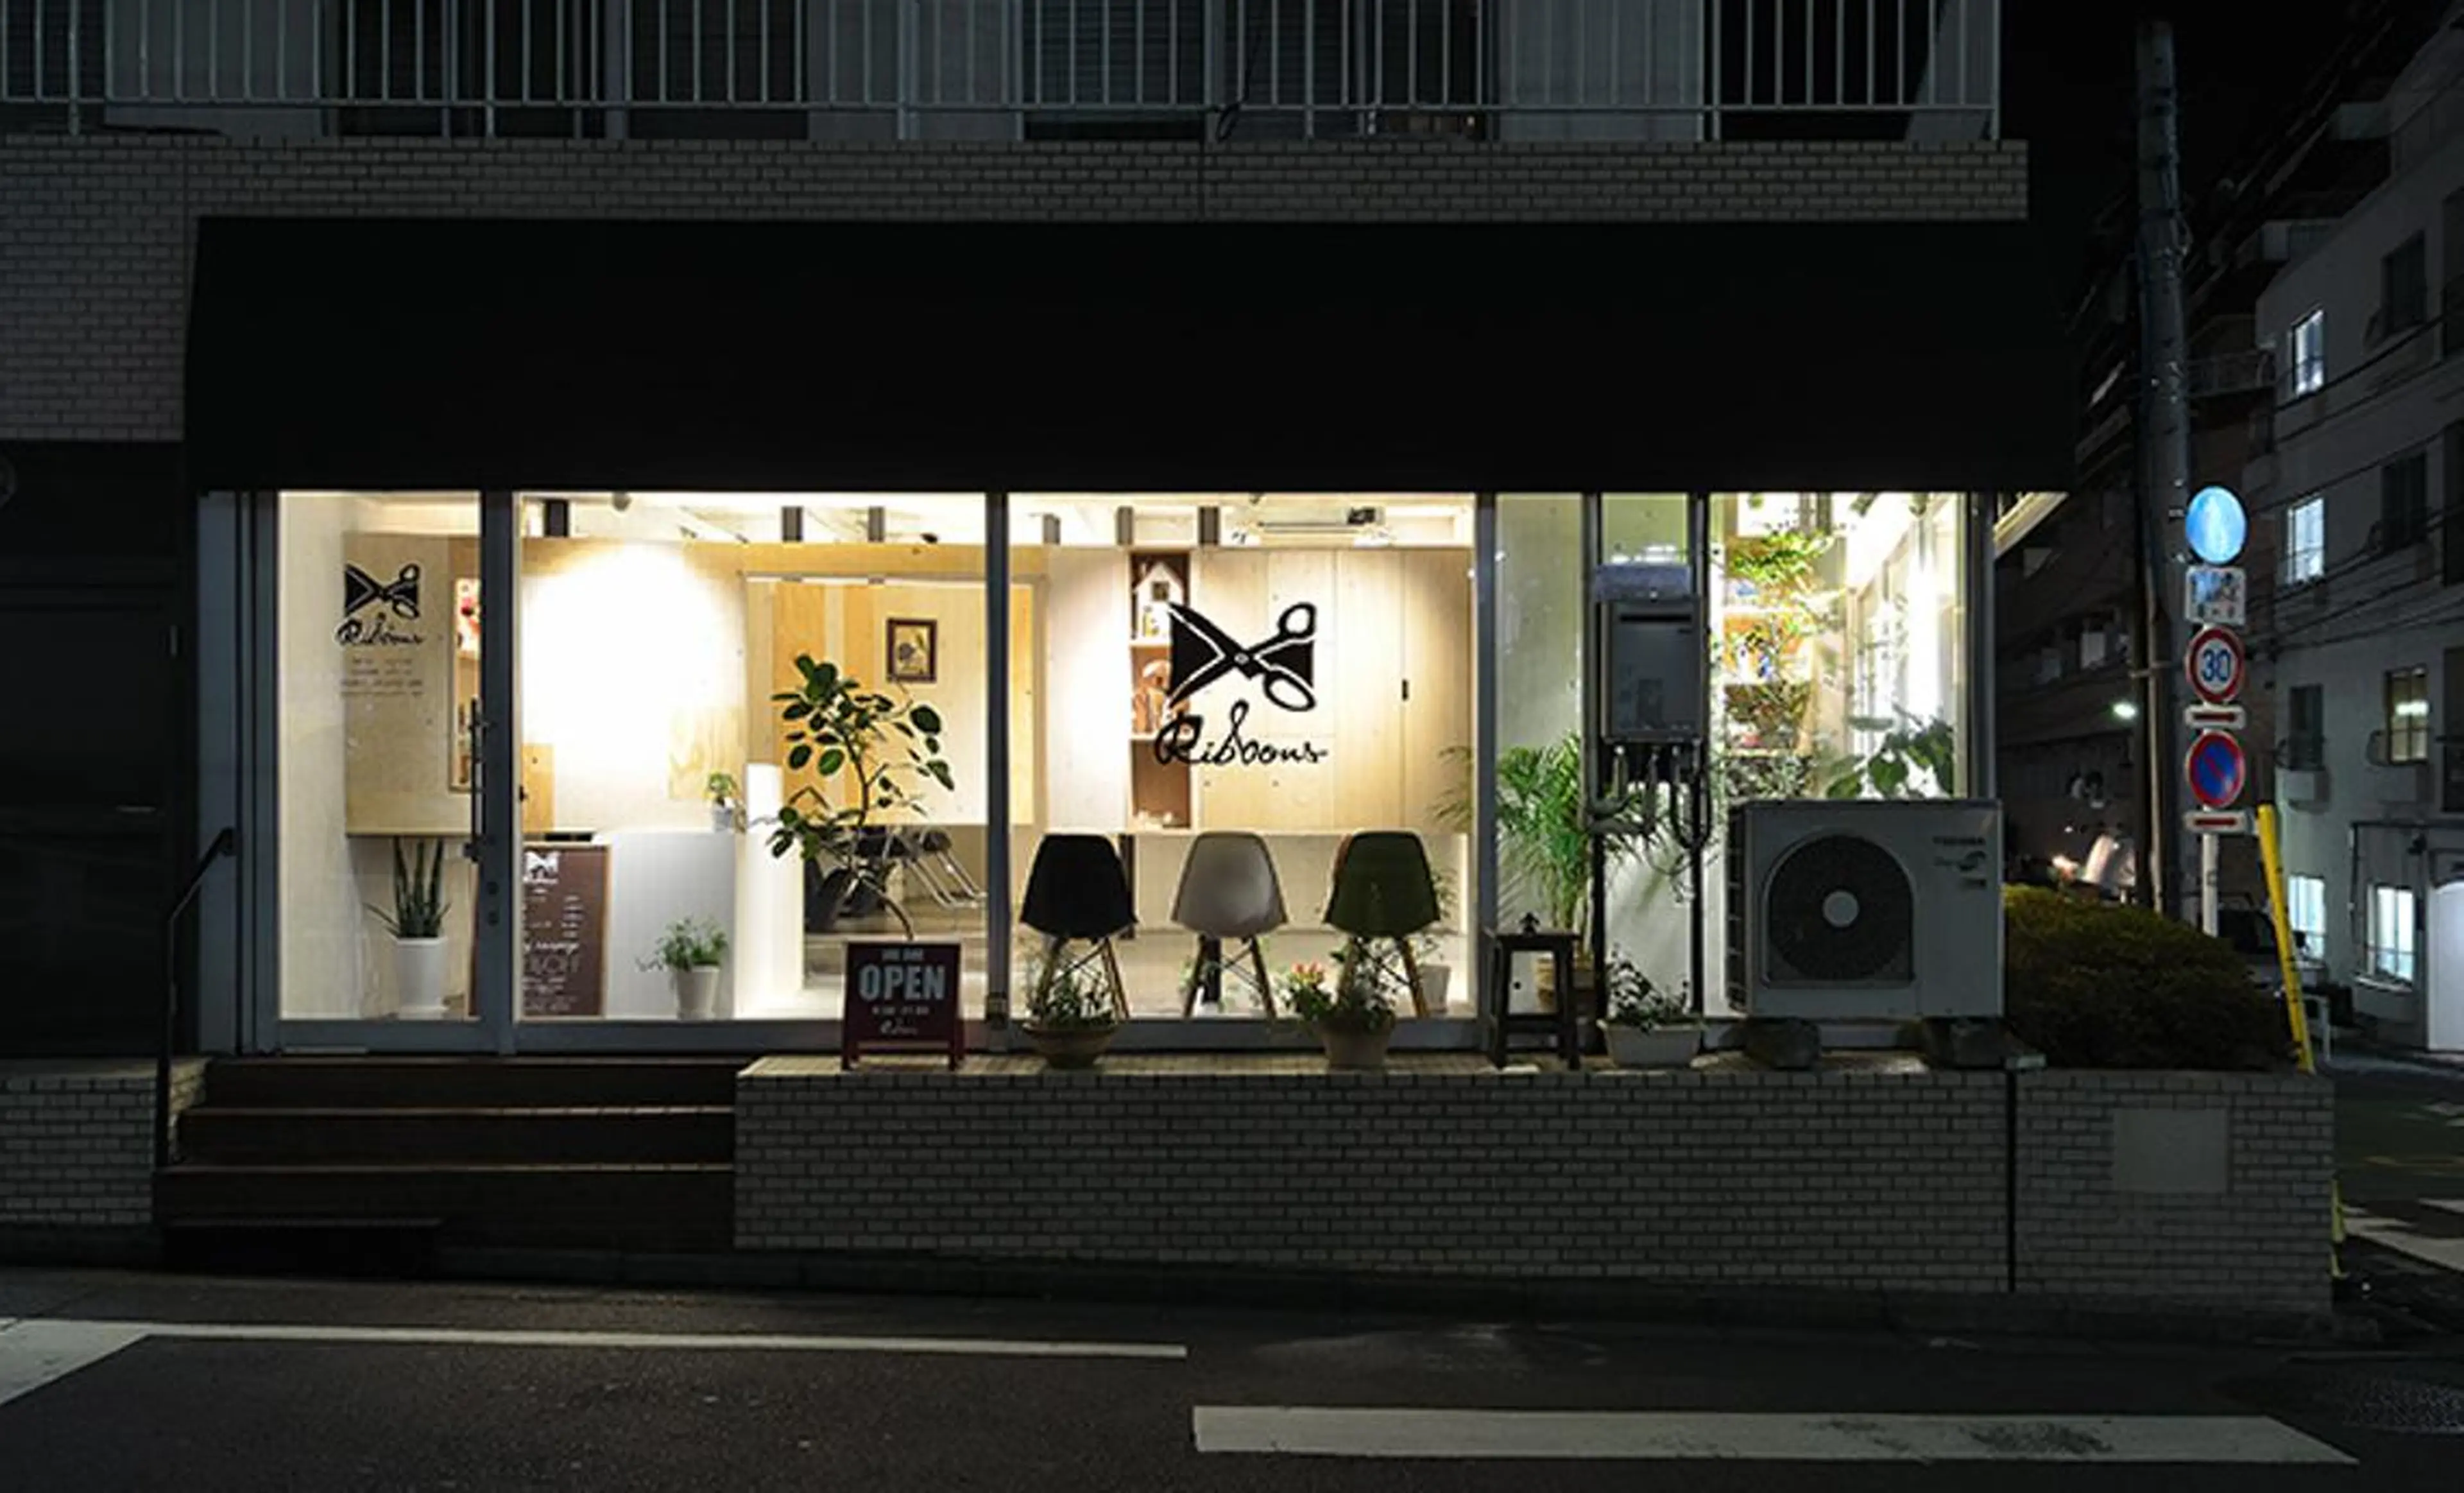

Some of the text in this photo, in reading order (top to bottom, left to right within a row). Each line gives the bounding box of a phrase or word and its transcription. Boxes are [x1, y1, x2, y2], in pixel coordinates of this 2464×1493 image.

[2201, 648, 2232, 683] 30
[1154, 698, 1328, 765] Ribbons
[859, 963, 946, 1002] OPEN
